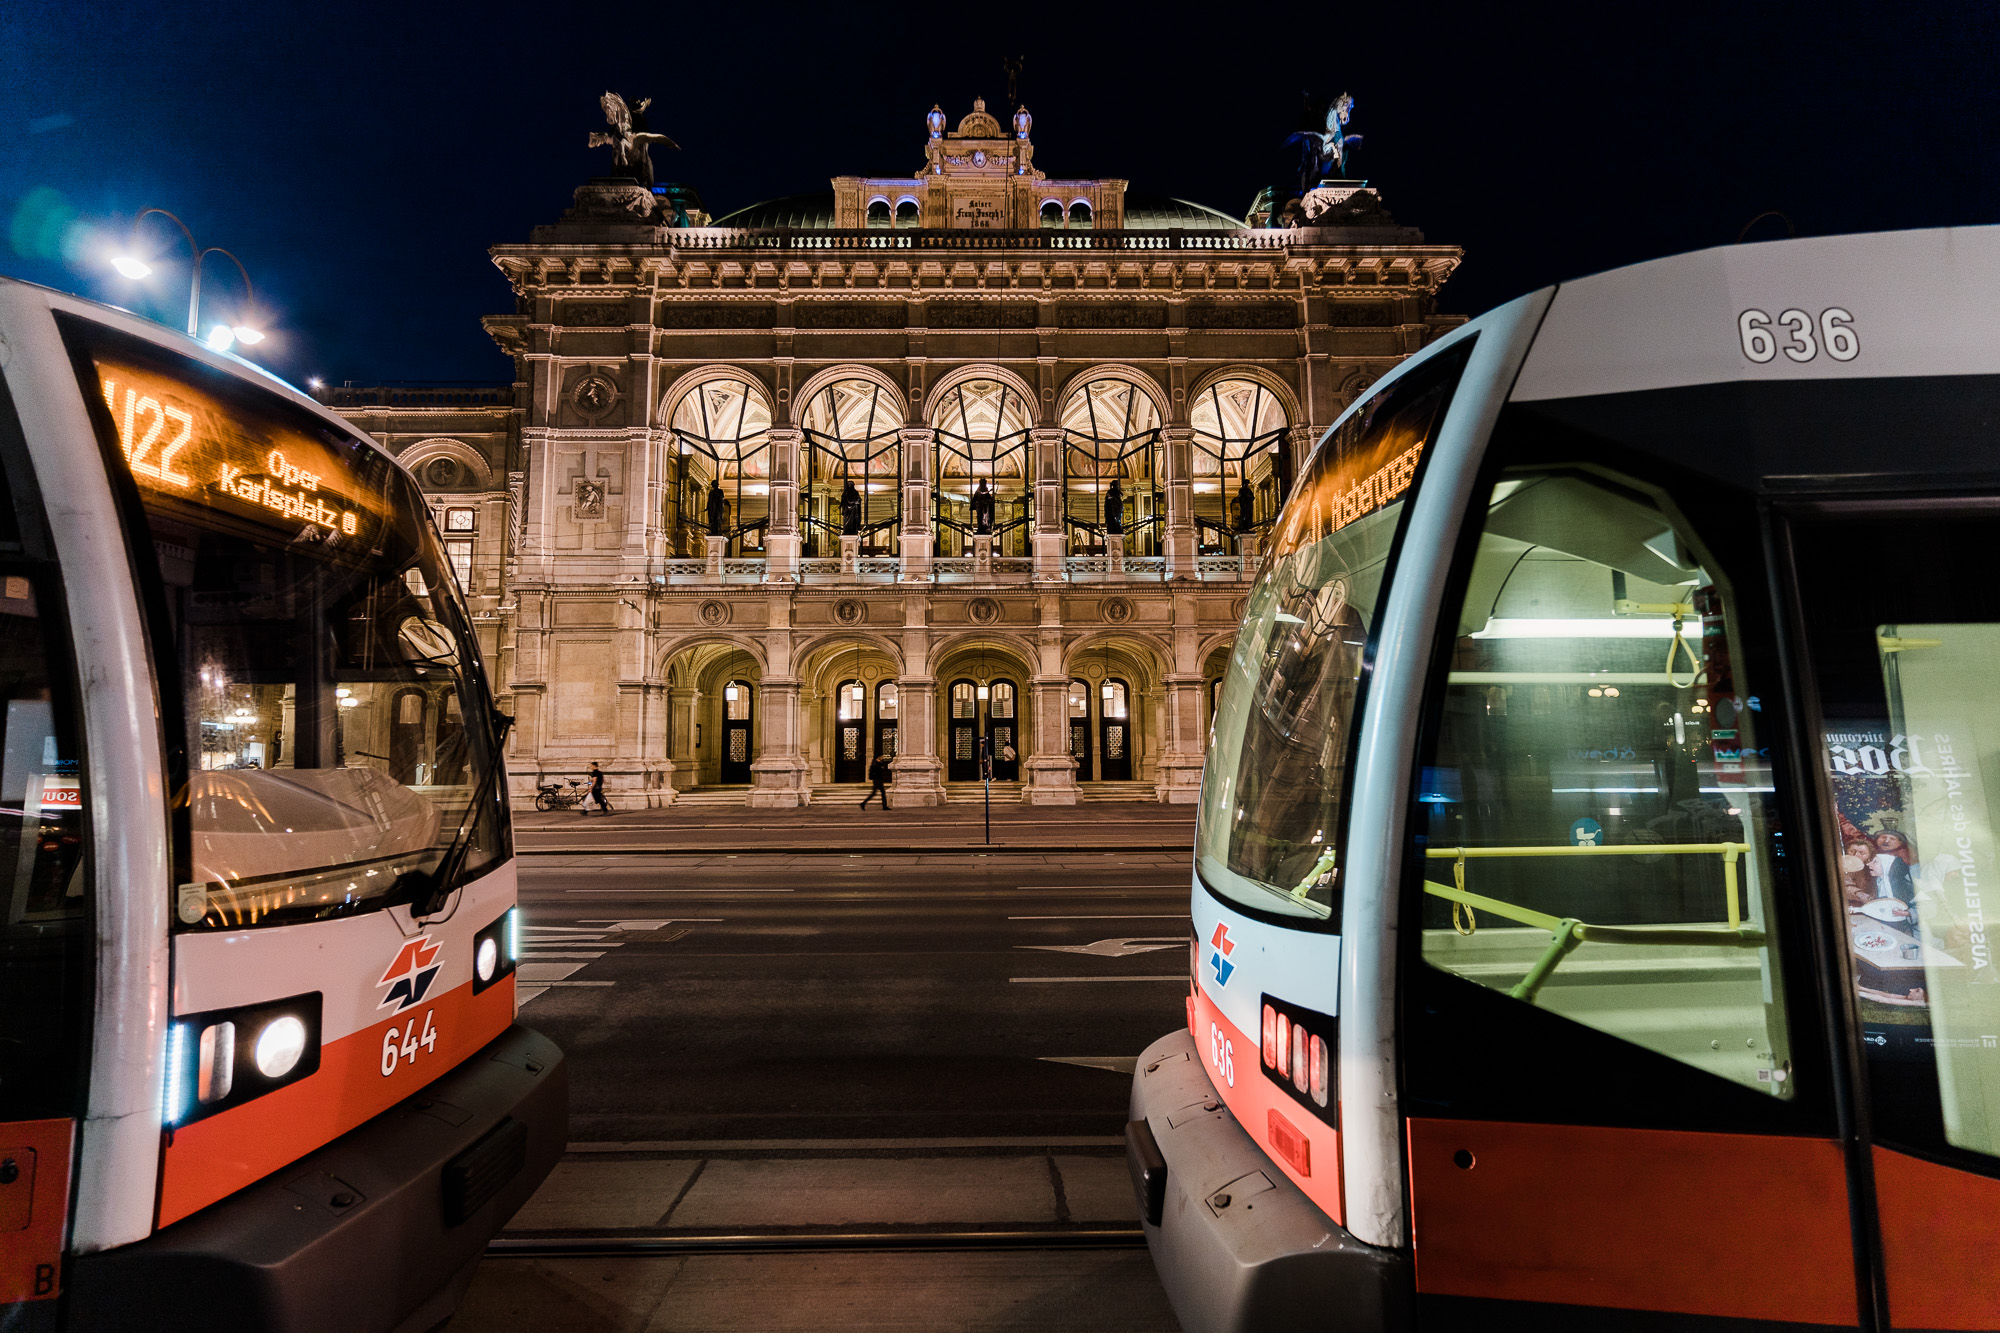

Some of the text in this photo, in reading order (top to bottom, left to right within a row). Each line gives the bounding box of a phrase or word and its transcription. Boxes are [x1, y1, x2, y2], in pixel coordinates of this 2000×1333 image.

[956, 208, 975, 220] Franz
[976, 208, 999, 221] Joseph
[969, 200, 992, 208] Kaiser
[971, 220, 990, 228] 1868
[1737, 306, 1860, 364] 636
[268, 449, 322, 491] Oper
[220, 462, 338, 528] Karlsplatz
[380, 1008, 437, 1077] 644
[1211, 1020, 1235, 1089] 636
[34, 1263, 54, 1296] B
